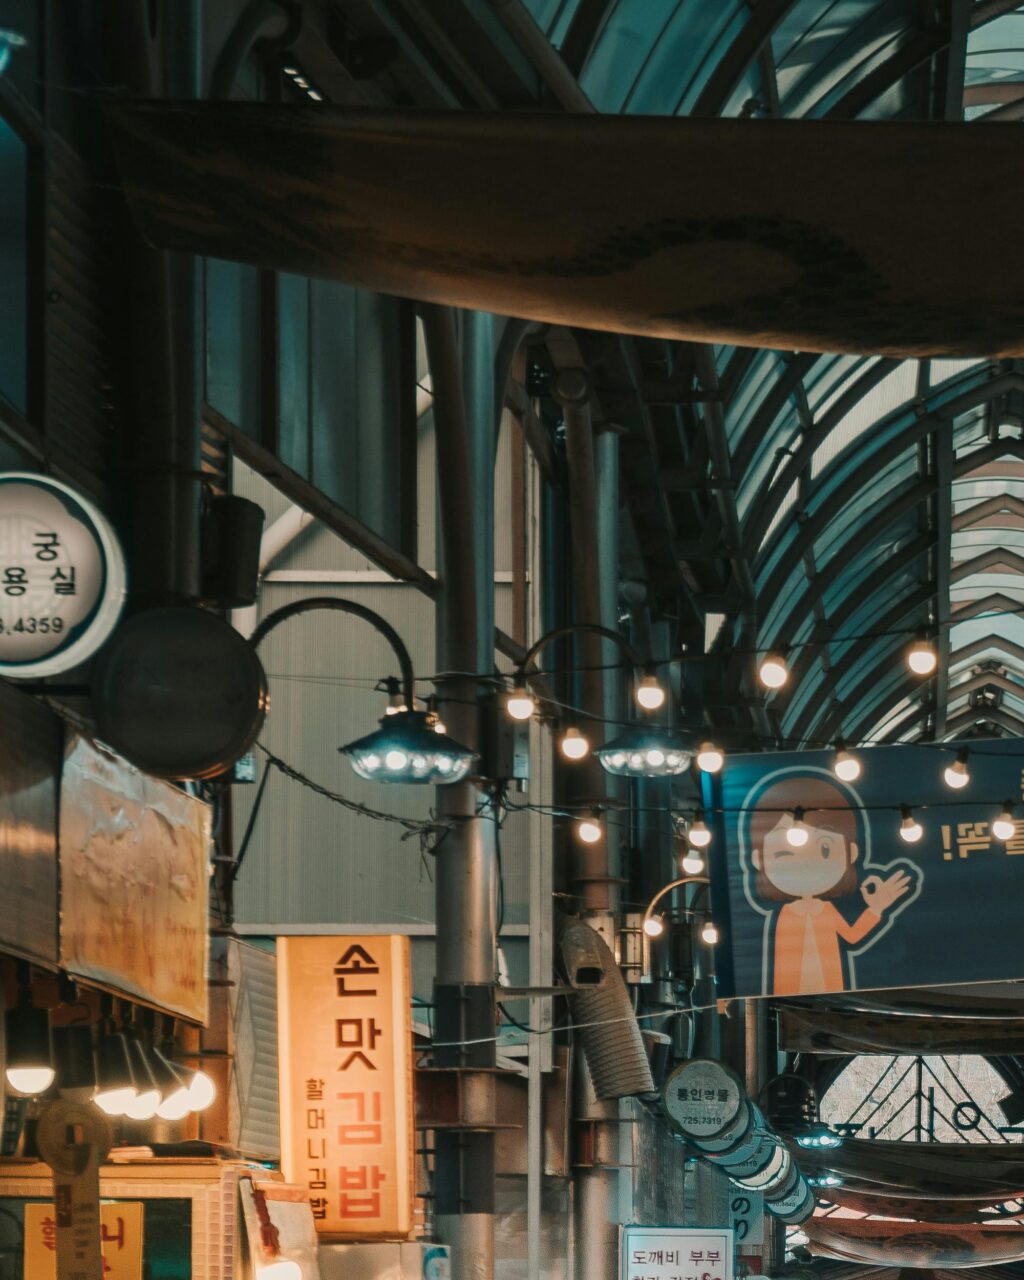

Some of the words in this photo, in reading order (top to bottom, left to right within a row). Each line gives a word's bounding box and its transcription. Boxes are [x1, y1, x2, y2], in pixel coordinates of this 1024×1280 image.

[32, 531, 61, 562] 궁
[631, 1249, 680, 1266] 도깨비
[688, 1250, 722, 1267] 부부
